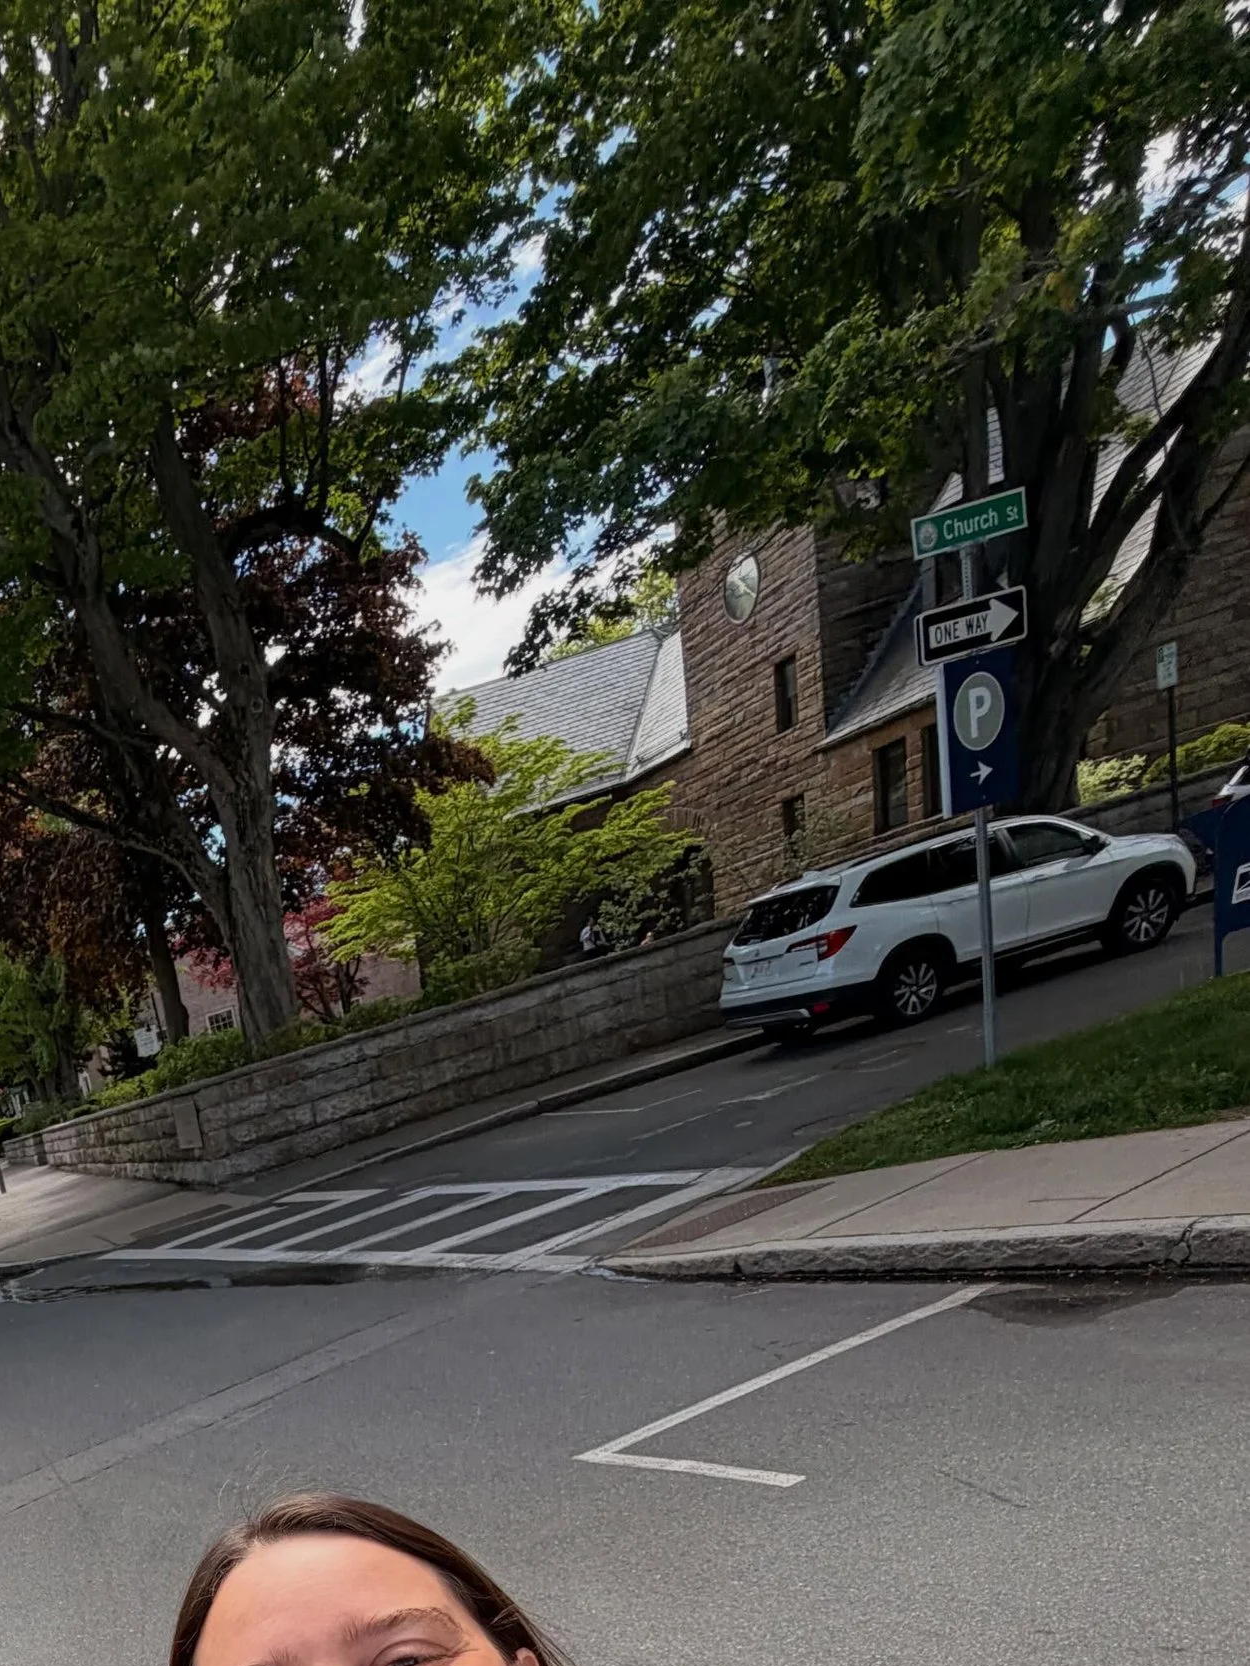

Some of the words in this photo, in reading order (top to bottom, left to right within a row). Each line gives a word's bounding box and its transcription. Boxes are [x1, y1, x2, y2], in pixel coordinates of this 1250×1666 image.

[943, 508, 998, 540] Church
[1006, 506, 1019, 521] St
[934, 621, 960, 644] ONE
[965, 613, 989, 637] WAY
[968, 687, 992, 738] P
